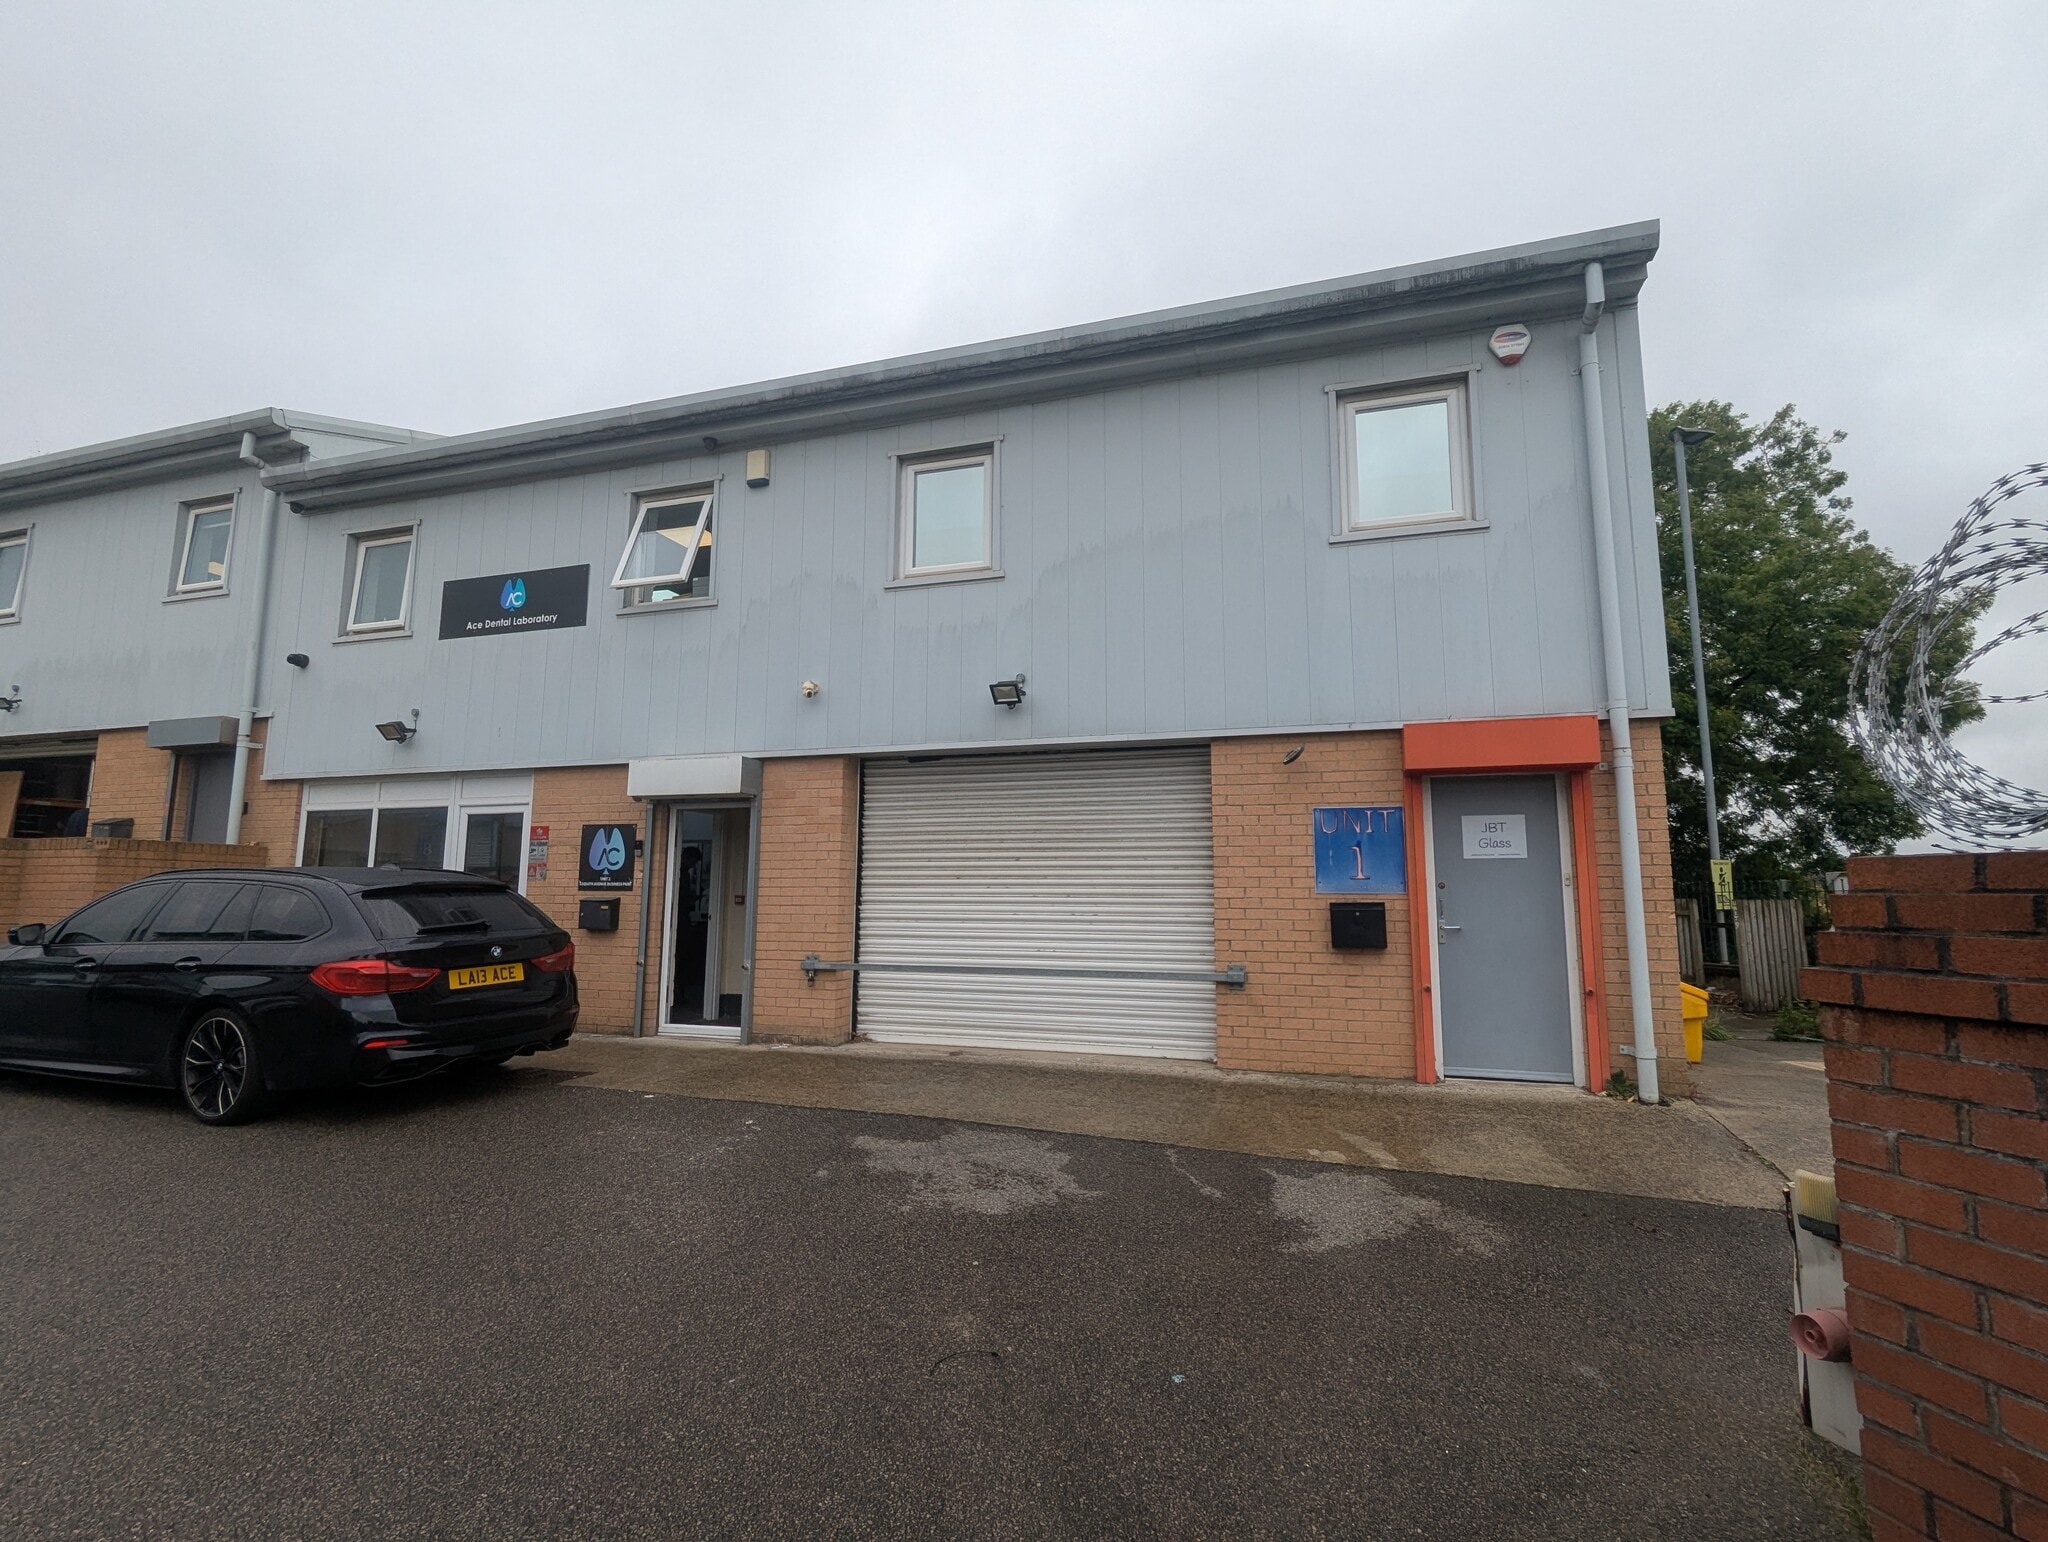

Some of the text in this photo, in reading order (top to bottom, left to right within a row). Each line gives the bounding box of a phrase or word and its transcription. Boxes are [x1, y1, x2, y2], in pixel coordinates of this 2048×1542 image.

[466, 614, 558, 630] Ace Dental Laboratory
[1320, 809, 1396, 834] UNIT
[1481, 822, 1507, 833] JBT
[1479, 837, 1512, 849] Glass
[597, 847, 620, 866] AC
[1349, 846, 1371, 880] 1
[458, 966, 516, 986] LA13 ACE
